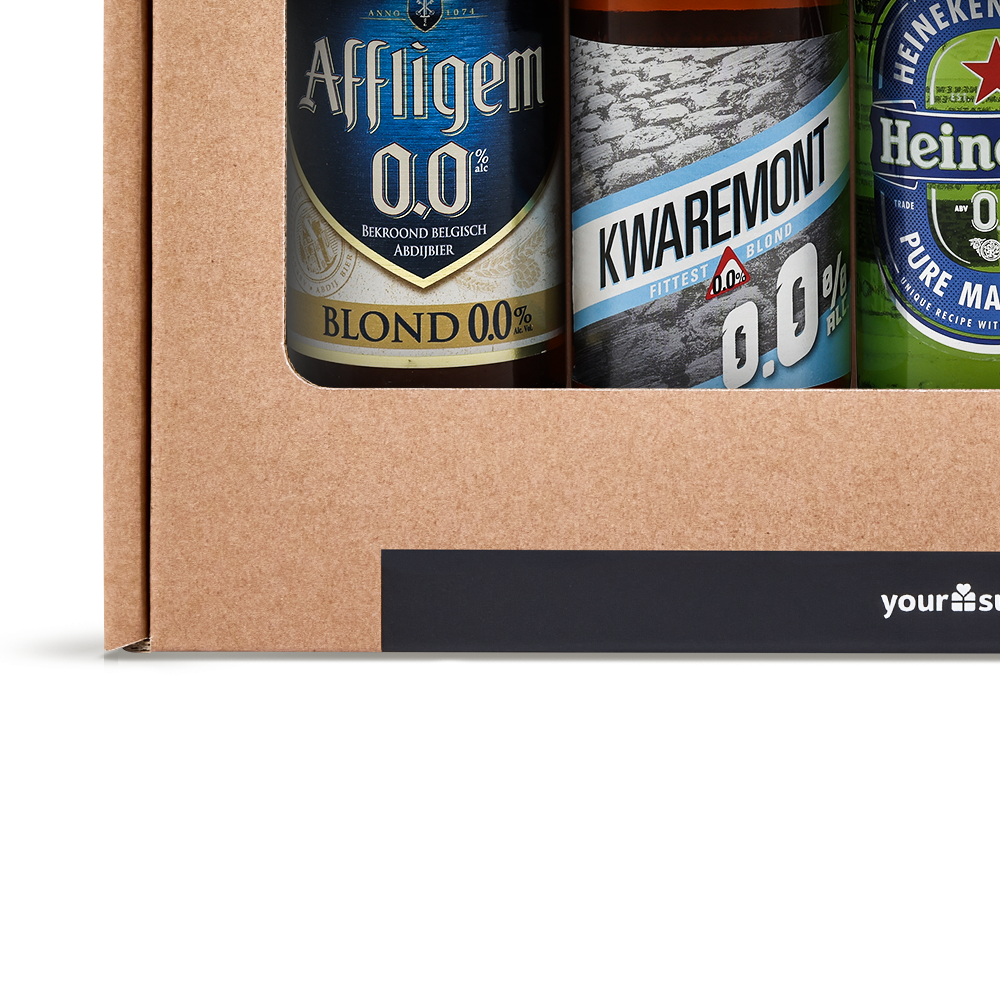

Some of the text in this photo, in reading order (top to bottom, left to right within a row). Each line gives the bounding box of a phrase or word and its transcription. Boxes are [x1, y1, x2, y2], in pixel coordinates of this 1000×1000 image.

[368, 7, 476, 17] ANNO 1074
[299, 36, 545, 136] Affligem
[950, 91, 971, 103] EST.
[474, 162, 488, 173] alc
[600, 117, 829, 290] KWAREMONT
[894, 199, 915, 210] TRADE
[954, 204, 969, 213] ABV
[361, 224, 487, 239] BEKROOND BELGISCH
[393, 244, 455, 260] ABDIJBIER
[649, 222, 793, 299] FITTEST BLOND
[900, 231, 953, 297] PURE
[316, 254, 353, 293] ABDIJ BIER
[712, 269, 747, 295] 0.0%
[901, 276, 932, 312] UNIQUE
[935, 308, 973, 328] RECIPE
[322, 305, 460, 344] BLOND
